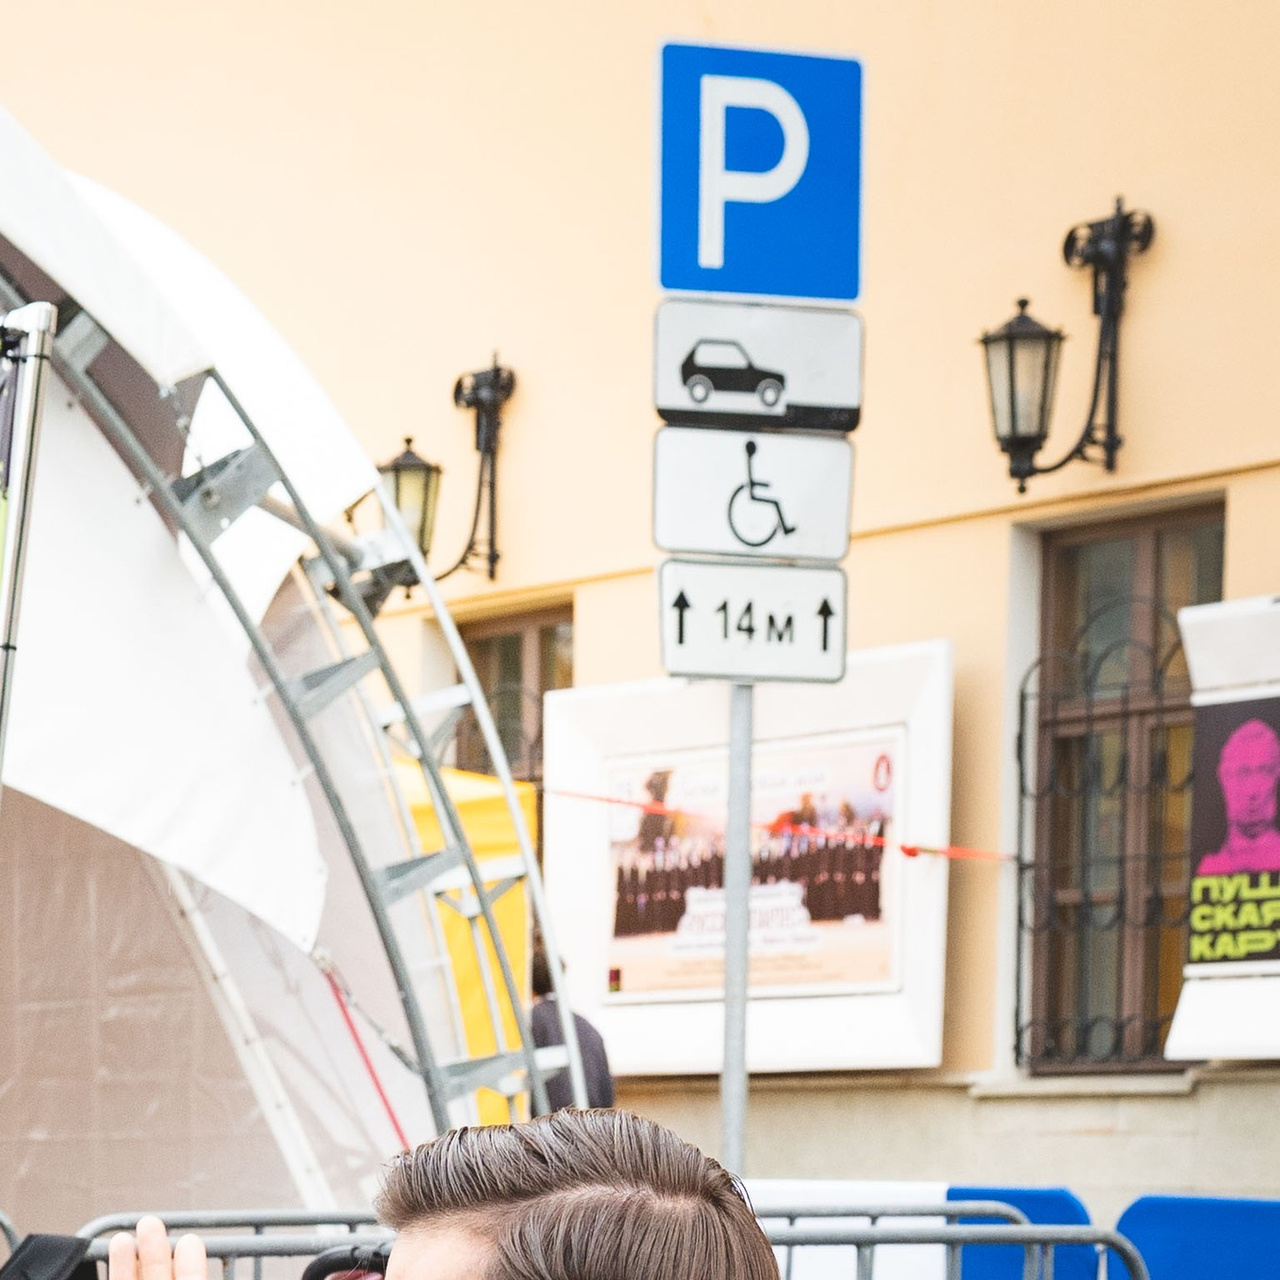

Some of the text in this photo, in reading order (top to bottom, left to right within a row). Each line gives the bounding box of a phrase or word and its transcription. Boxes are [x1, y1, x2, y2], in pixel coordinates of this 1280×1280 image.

[699, 74, 810, 269] P
[716, 600, 756, 640] 14
[1190, 928, 1280, 961] КАР
